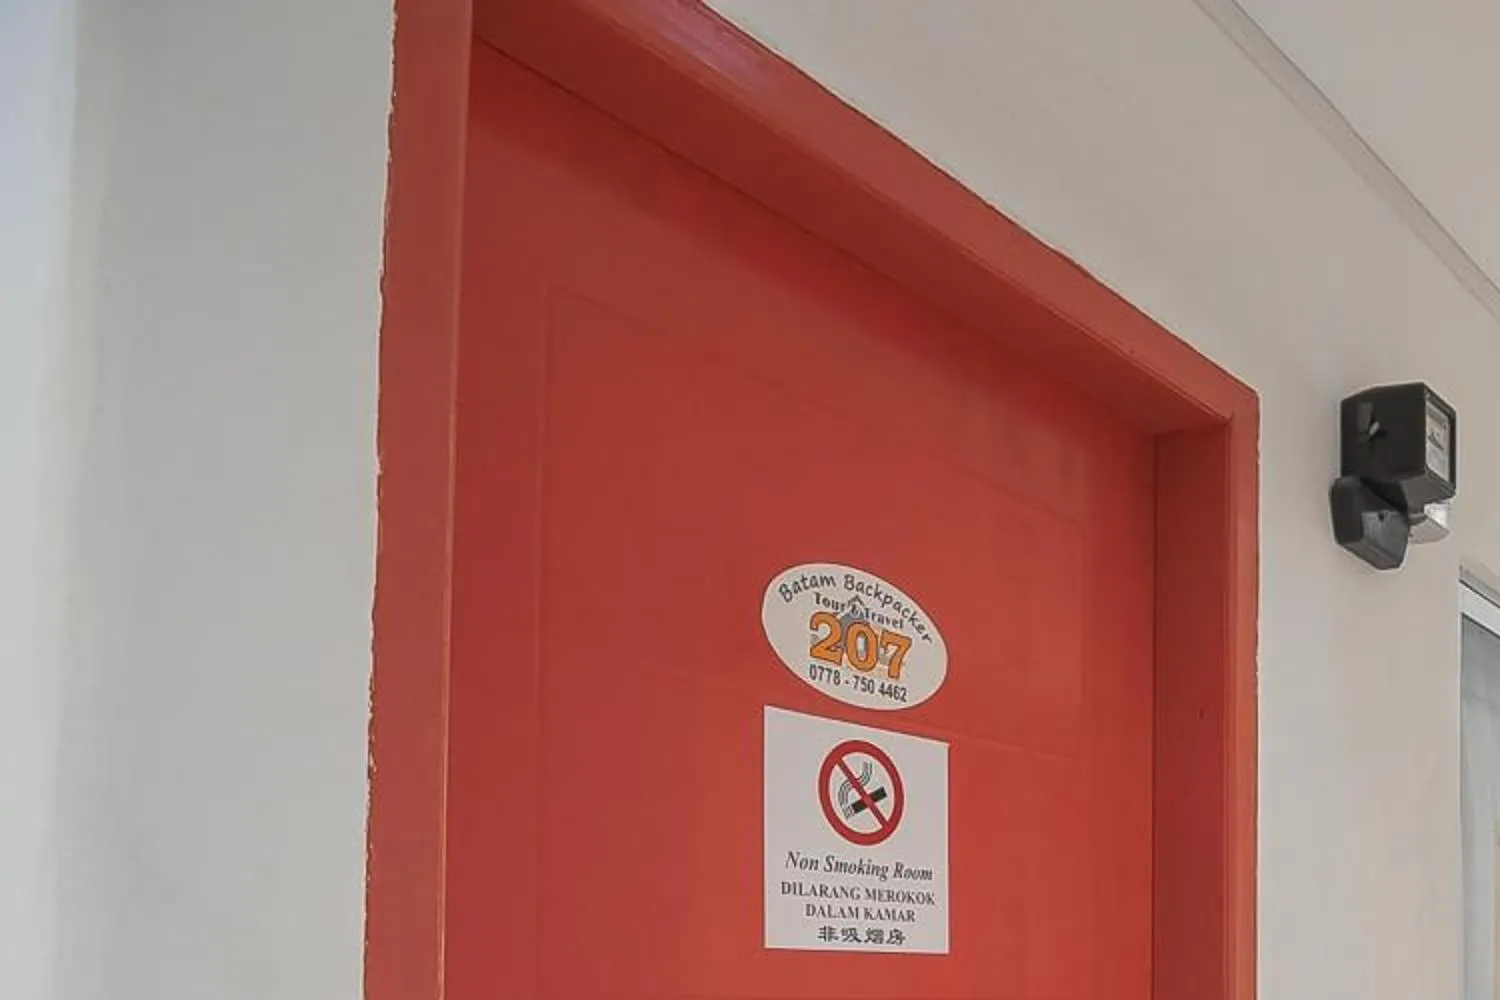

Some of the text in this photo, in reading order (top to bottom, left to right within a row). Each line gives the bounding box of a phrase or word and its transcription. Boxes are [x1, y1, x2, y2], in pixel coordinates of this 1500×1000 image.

[778, 574, 933, 644] Batam Backpacker
[813, 591, 845, 613] Tour
[862, 607, 904, 630] Travel
[809, 611, 912, 680] 207
[809, 664, 841, 687] 0778
[853, 676, 875, 694] 750
[878, 682, 908, 702] 4462
[785, 851, 933, 881] Non Smoking Room
[781, 881, 935, 905] DILARANG MEROKOK
[805, 904, 915, 923] DALAM KAMAR
[818, 925, 906, 946] 非吸烟房
